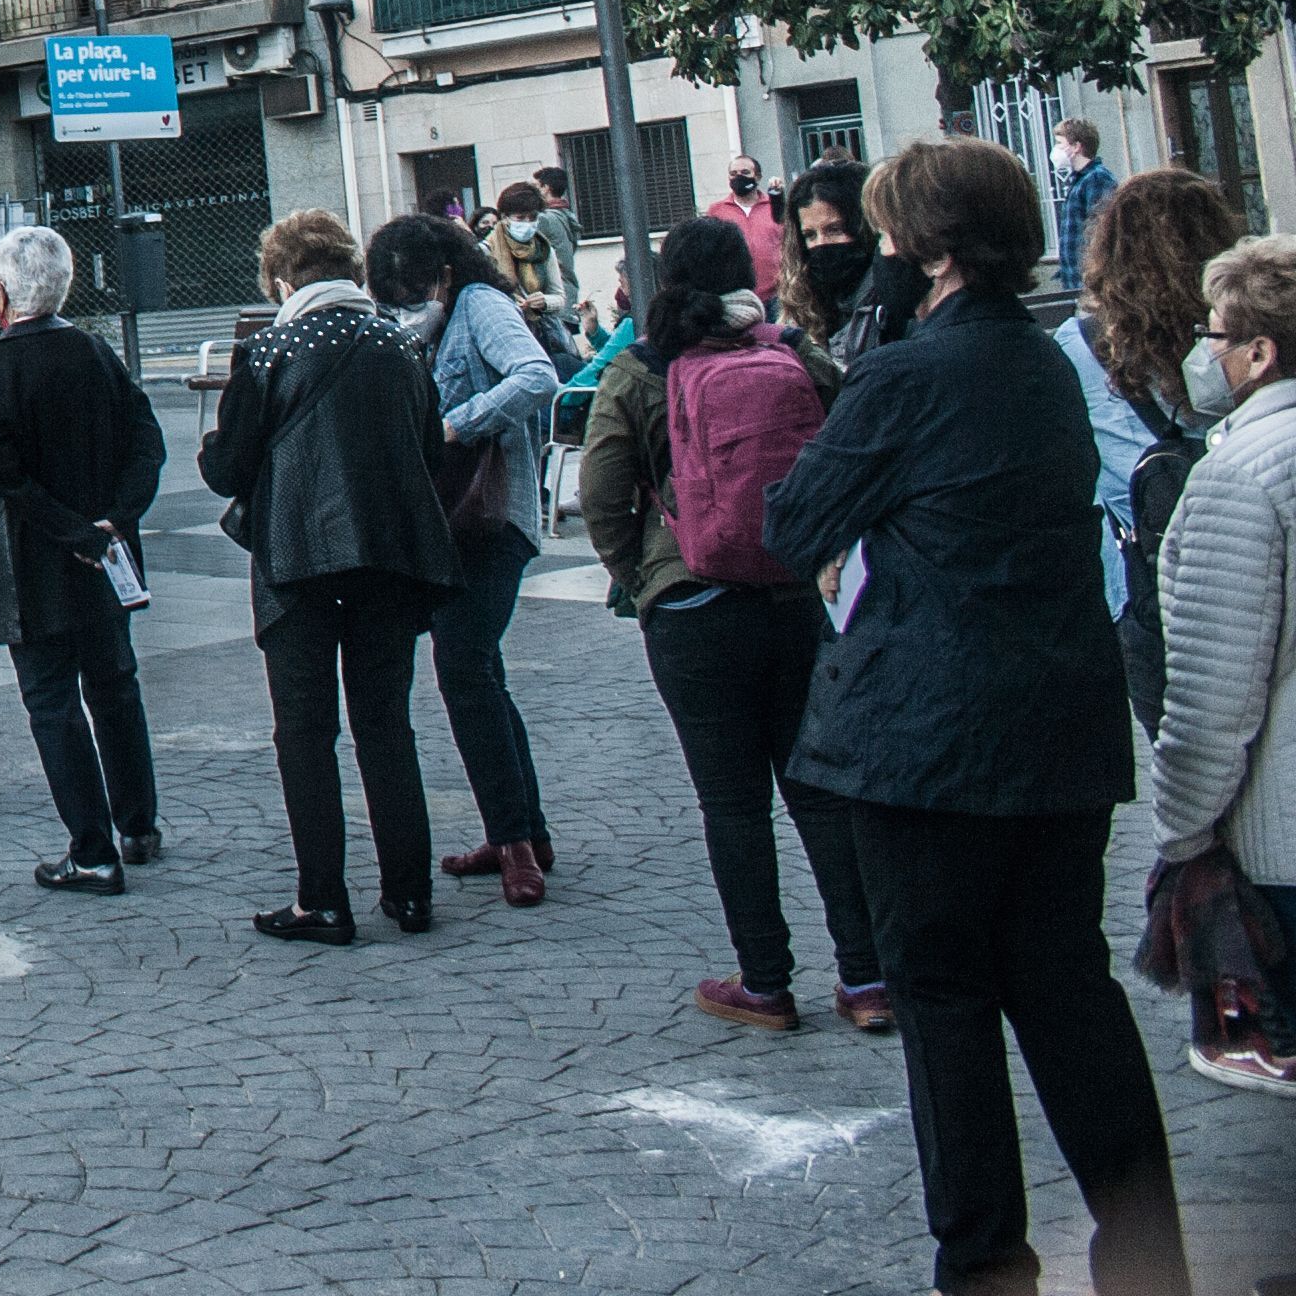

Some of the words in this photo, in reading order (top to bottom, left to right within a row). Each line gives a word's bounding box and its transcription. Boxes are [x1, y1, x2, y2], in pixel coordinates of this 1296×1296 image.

[53, 42, 74, 61] La
[77, 40, 128, 65] plaça,
[56, 68, 85, 88] per
[88, 62, 157, 82] viure-la
[49, 205, 101, 222] GOSBET
